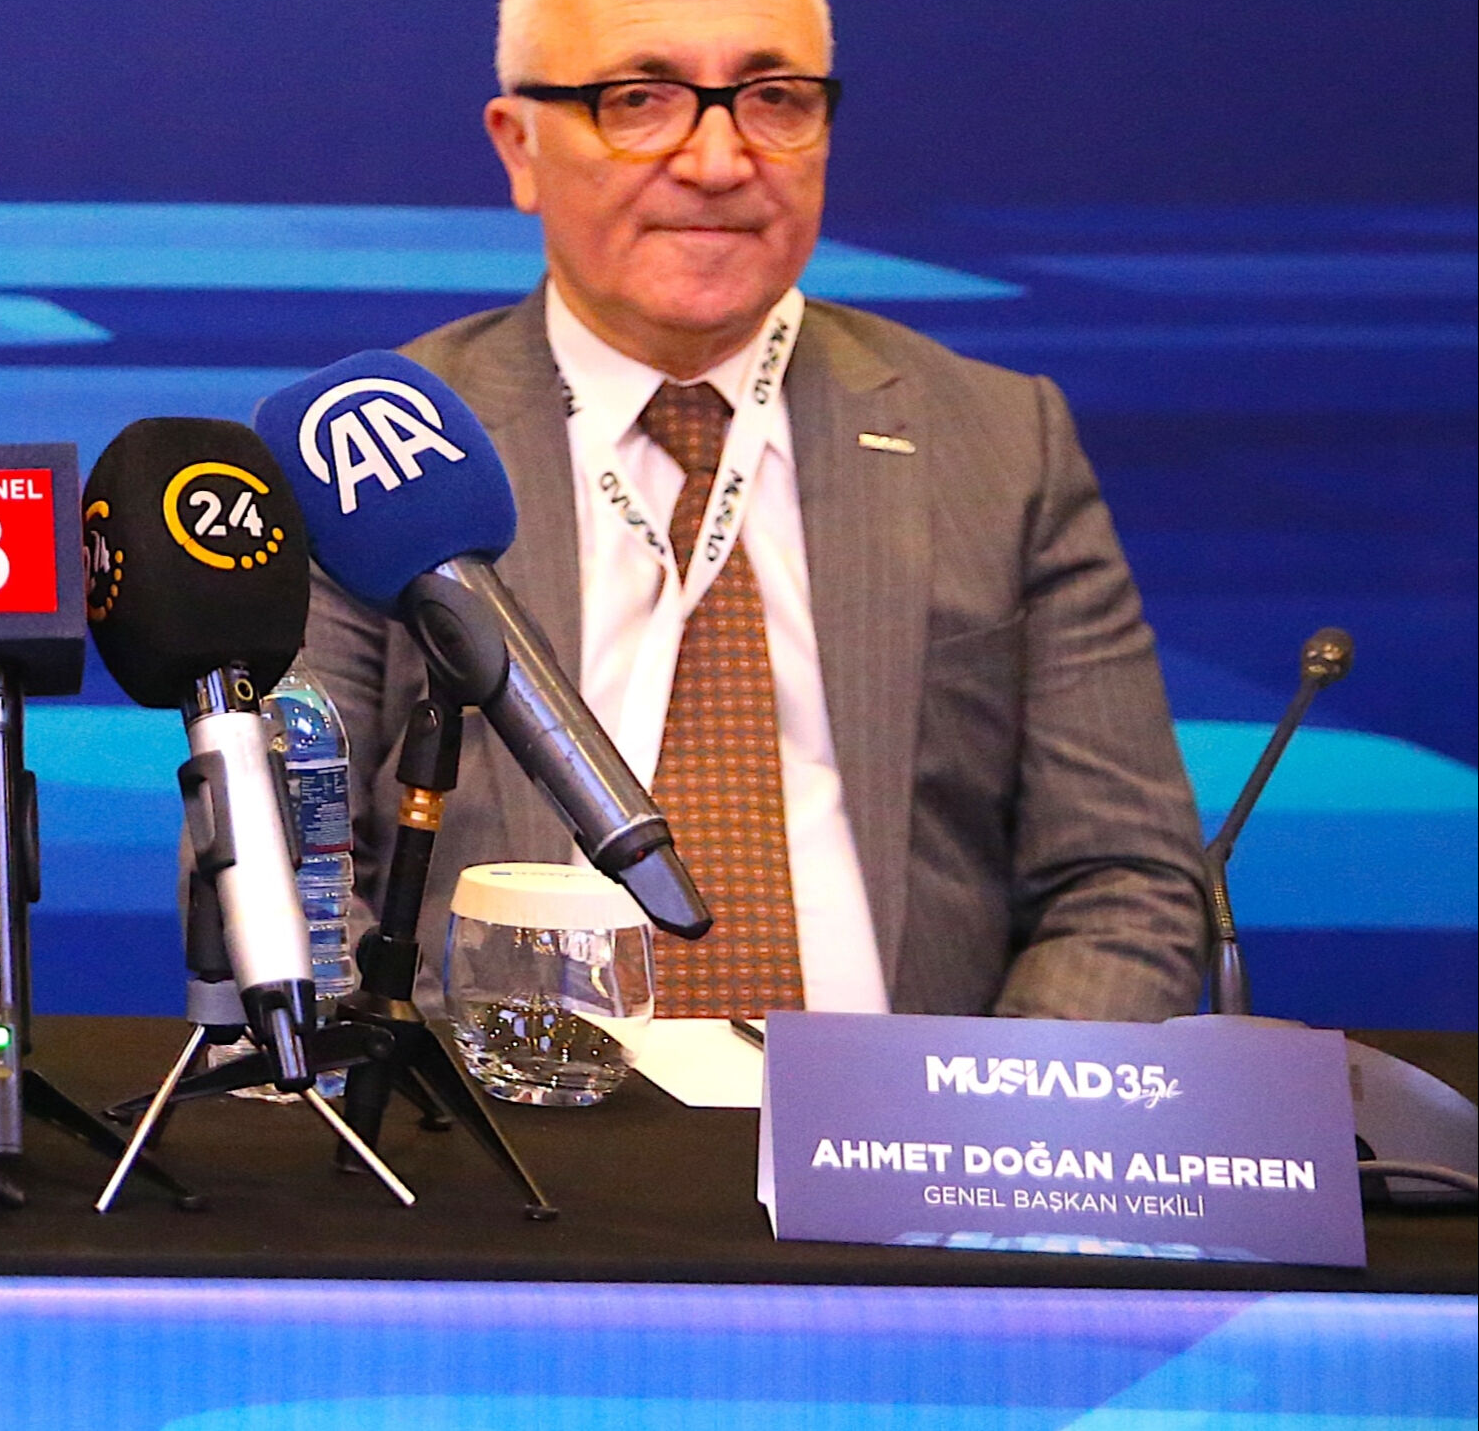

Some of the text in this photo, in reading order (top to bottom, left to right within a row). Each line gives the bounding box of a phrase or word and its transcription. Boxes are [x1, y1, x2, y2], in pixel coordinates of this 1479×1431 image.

[329, 396, 467, 515] AA
[188, 490, 264, 538] 24
[811, 1138, 1317, 1191] AHMET DOĞAN ALPEREN
[924, 1185, 1205, 1218] GENEL BAŞKAN VEKİLİ
